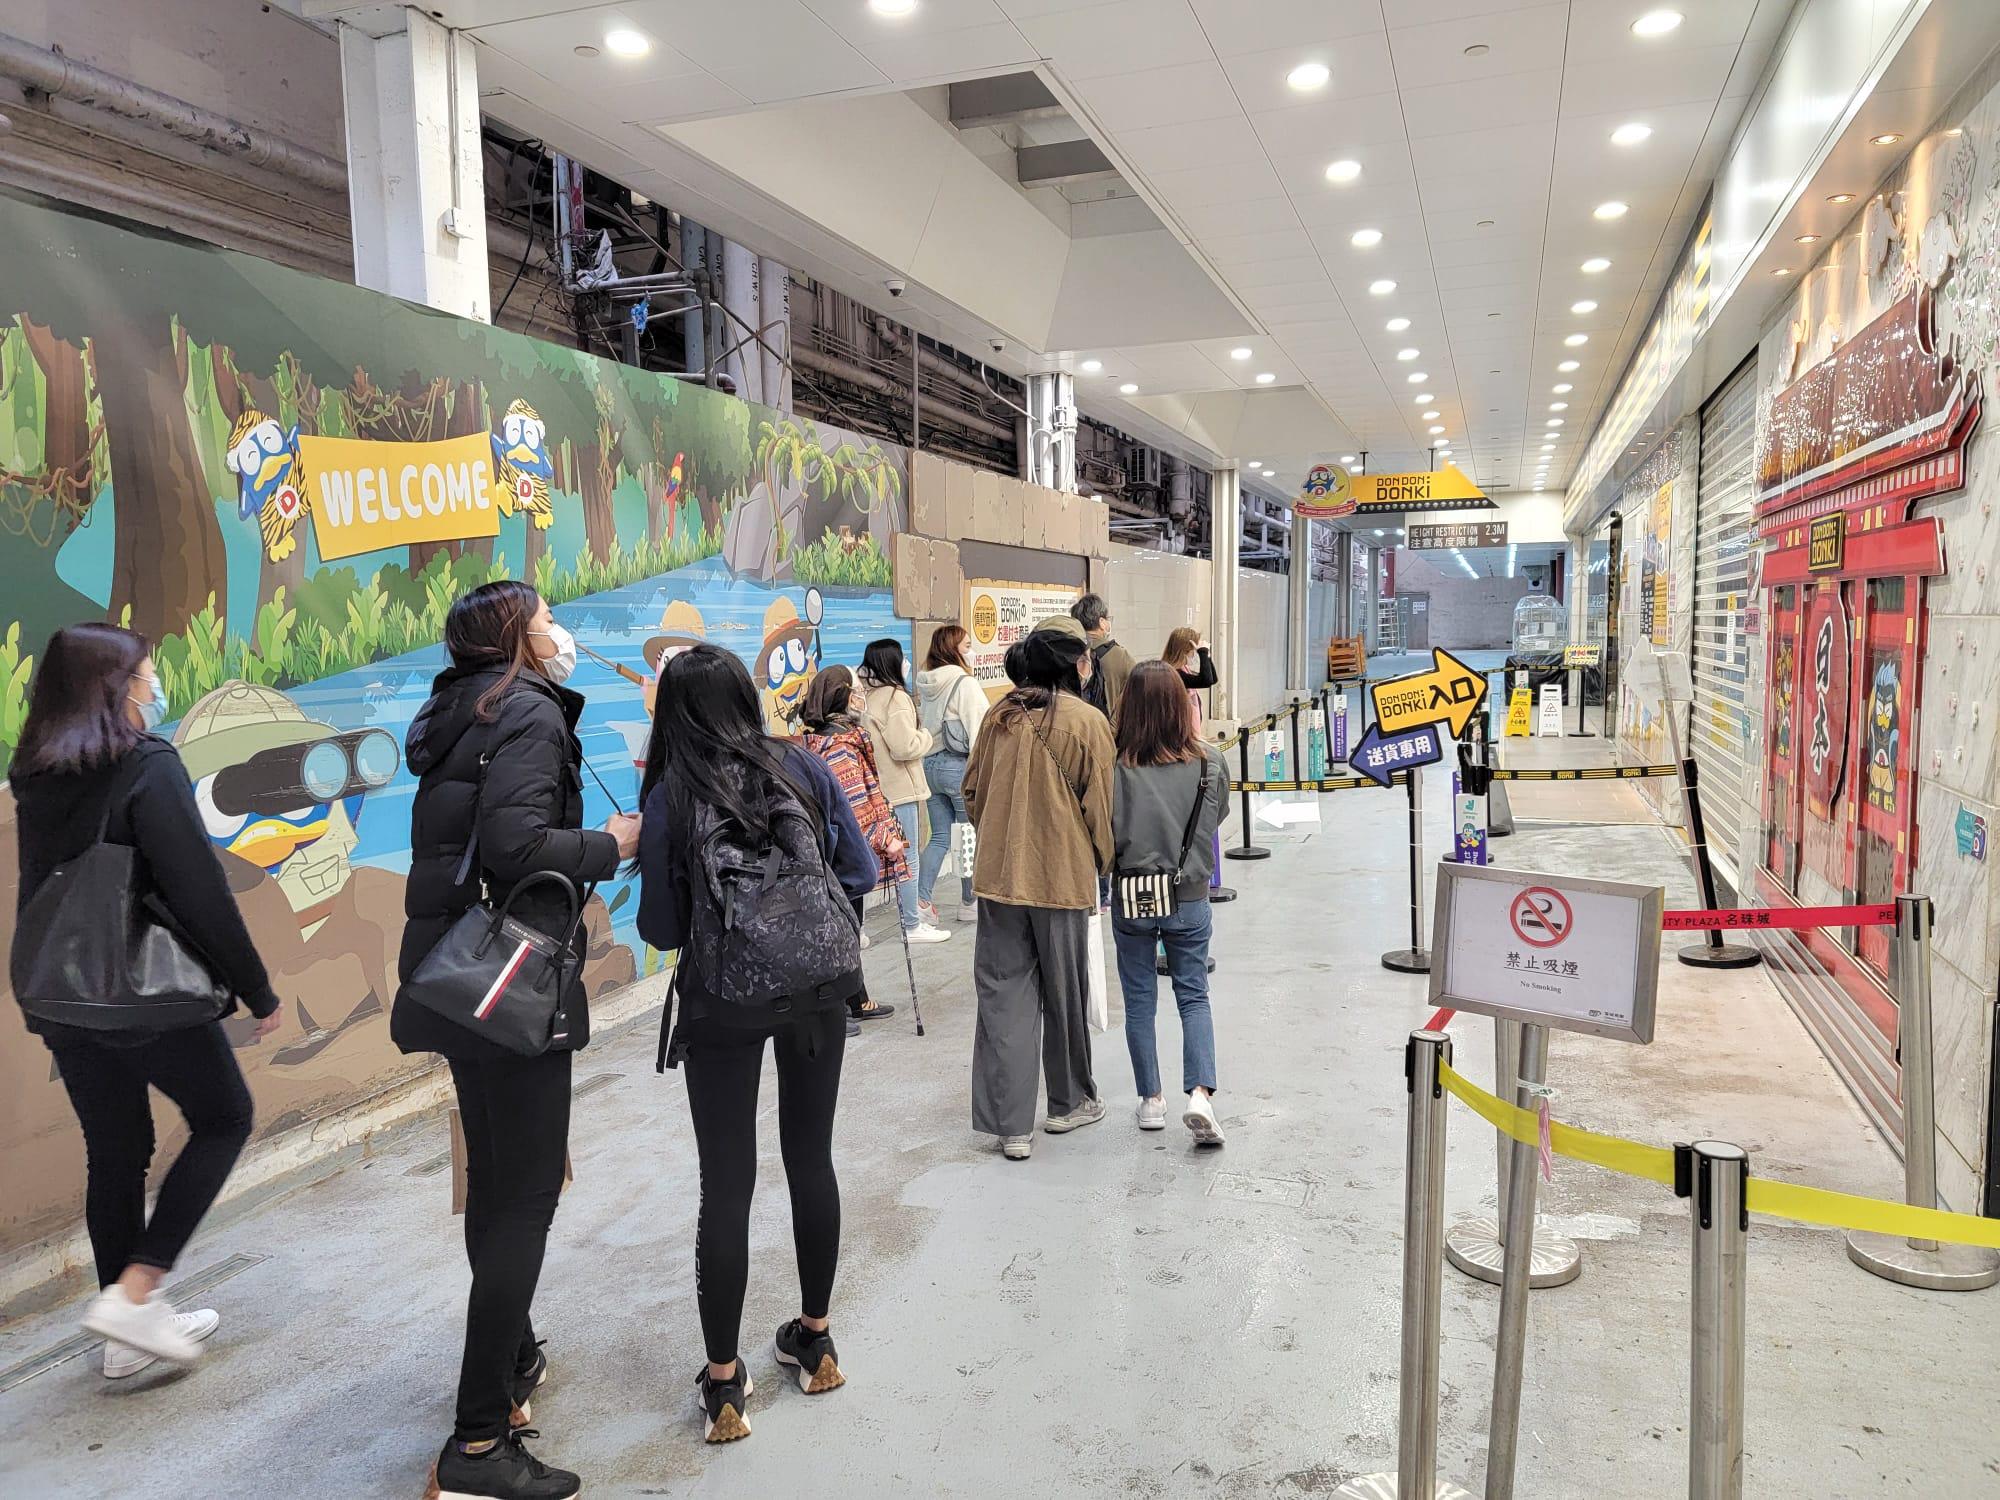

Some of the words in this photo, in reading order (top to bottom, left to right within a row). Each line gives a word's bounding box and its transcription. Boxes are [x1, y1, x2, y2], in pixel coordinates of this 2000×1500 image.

[320, 460, 490, 528] WELCOME
[1410, 527, 1434, 538] HEIGHT
[1435, 525, 1478, 537] RESTRICTION
[1485, 524, 1505, 536] 2.3M
[1410, 536, 1479, 549] 注意高度限制
[974, 665, 1005, 681] PRODUCTS
[1428, 676, 1477, 710] 入口
[1366, 735, 1432, 767] 送貨專用
[1685, 917, 1721, 926] PLAZA
[1725, 912, 1771, 926] 名珠城
[1506, 951, 1579, 976] 禁止吸煙
[1532, 983, 1562, 994] Smoking
